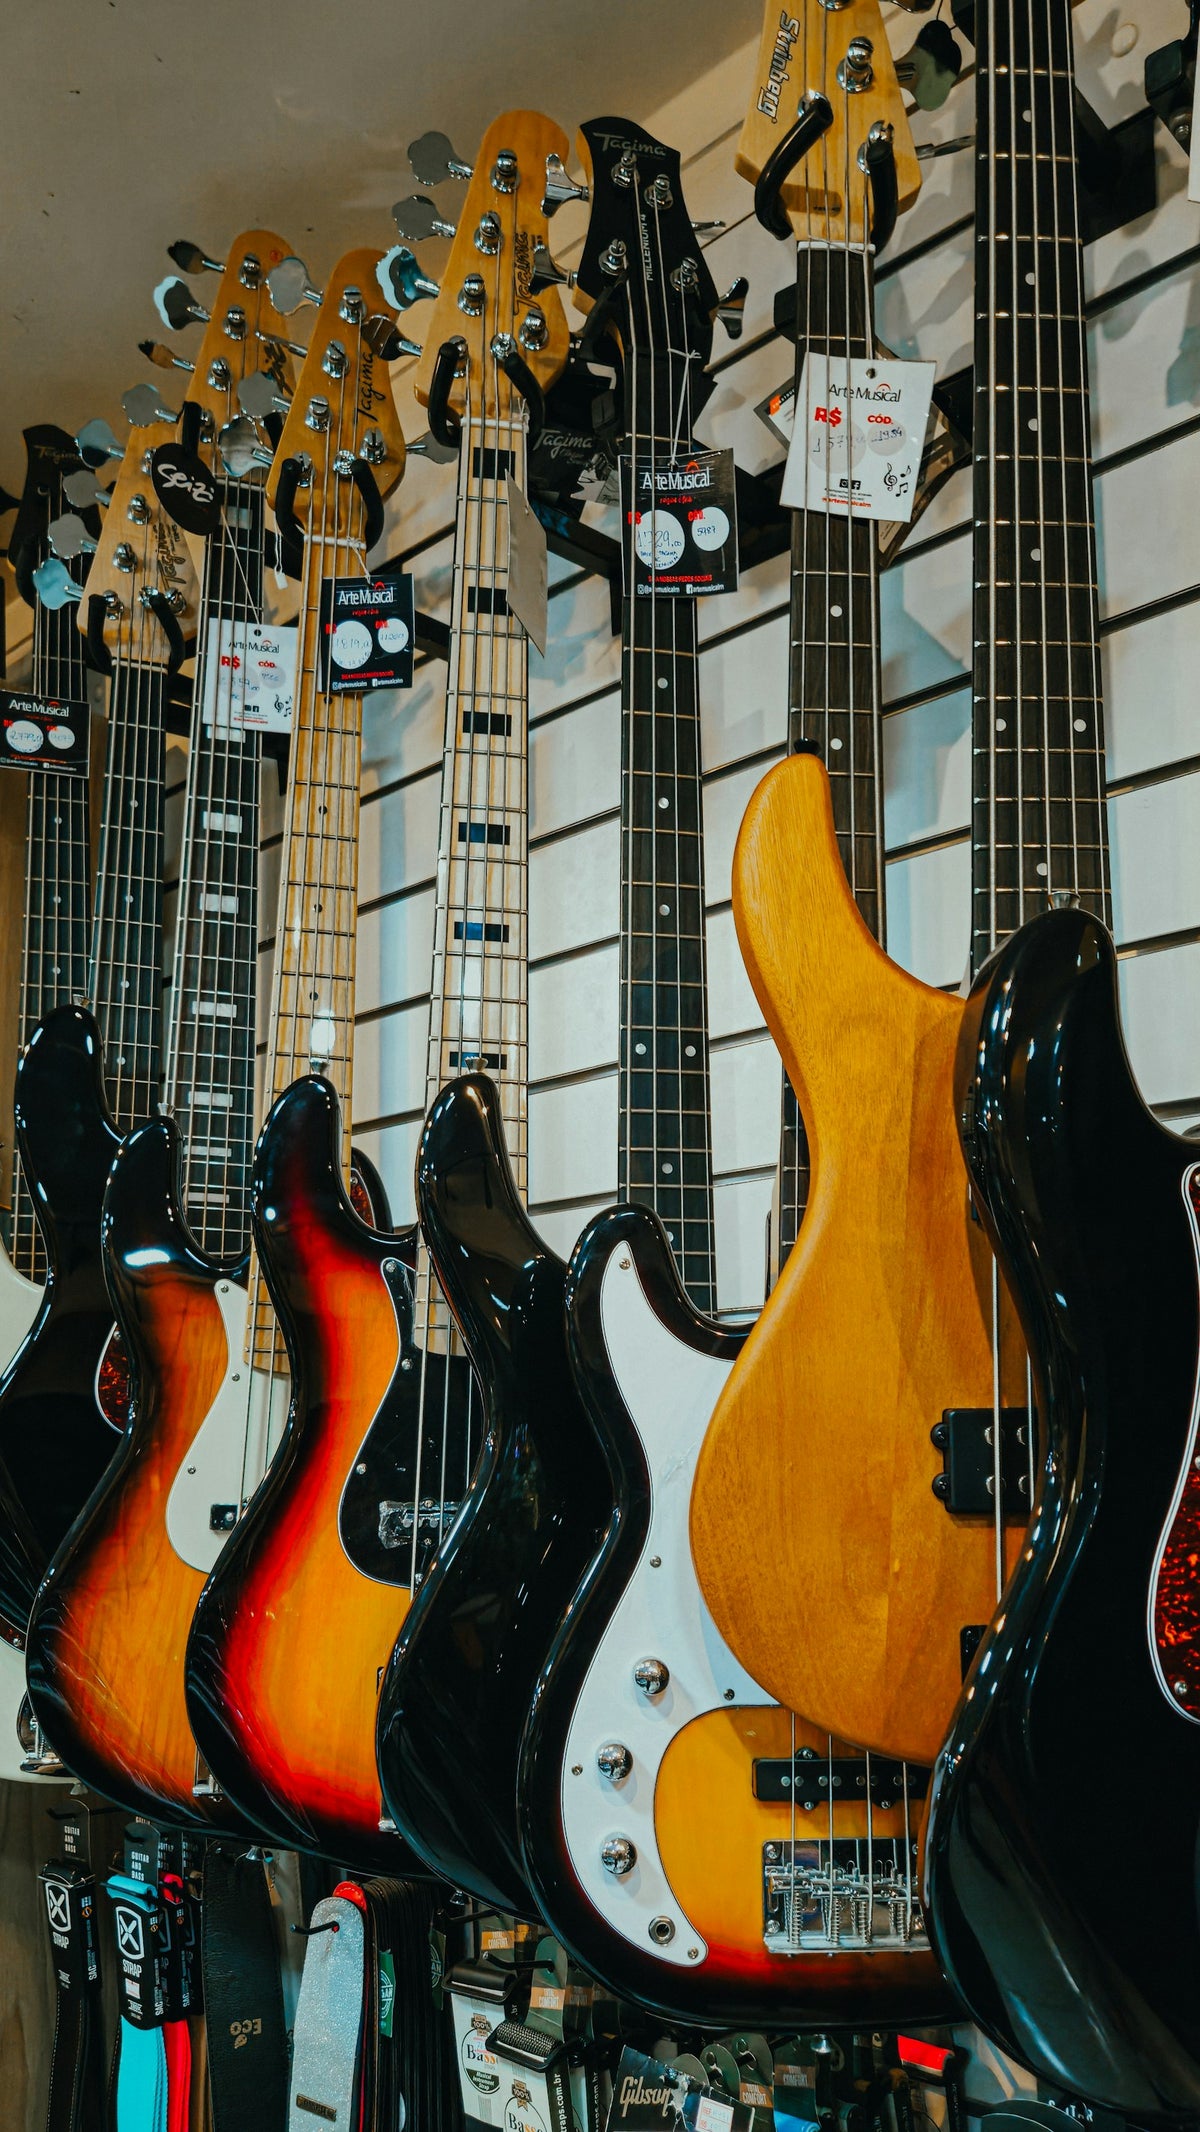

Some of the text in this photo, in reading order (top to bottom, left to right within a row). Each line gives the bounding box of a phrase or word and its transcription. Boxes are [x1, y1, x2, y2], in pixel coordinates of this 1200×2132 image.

[757, 9, 800, 120] Strinberg
[593, 132, 668, 156] Tagima
[643, 223, 654, 281] MILLENIUM
[356, 351, 386, 422] Tagima
[814, 406, 842, 427] R$
[532, 427, 593, 459] Tagima
[221, 655, 241, 670] R$
[64, 1825, 80, 1836] GUITAR
[64, 1834, 74, 1844] AND
[64, 1843, 77, 1854] BASS
[131, 1851, 150, 1863] GUITAR
[131, 1861, 142, 1871] AND
[131, 1870, 145, 1882] BASS
[52, 1931, 70, 1949] STRAP
[122, 1958, 143, 1978] STRAP
[229, 2018, 262, 2036] ECO
[466, 2043, 499, 2065] Bass
[619, 2075, 672, 2118] Gibson
